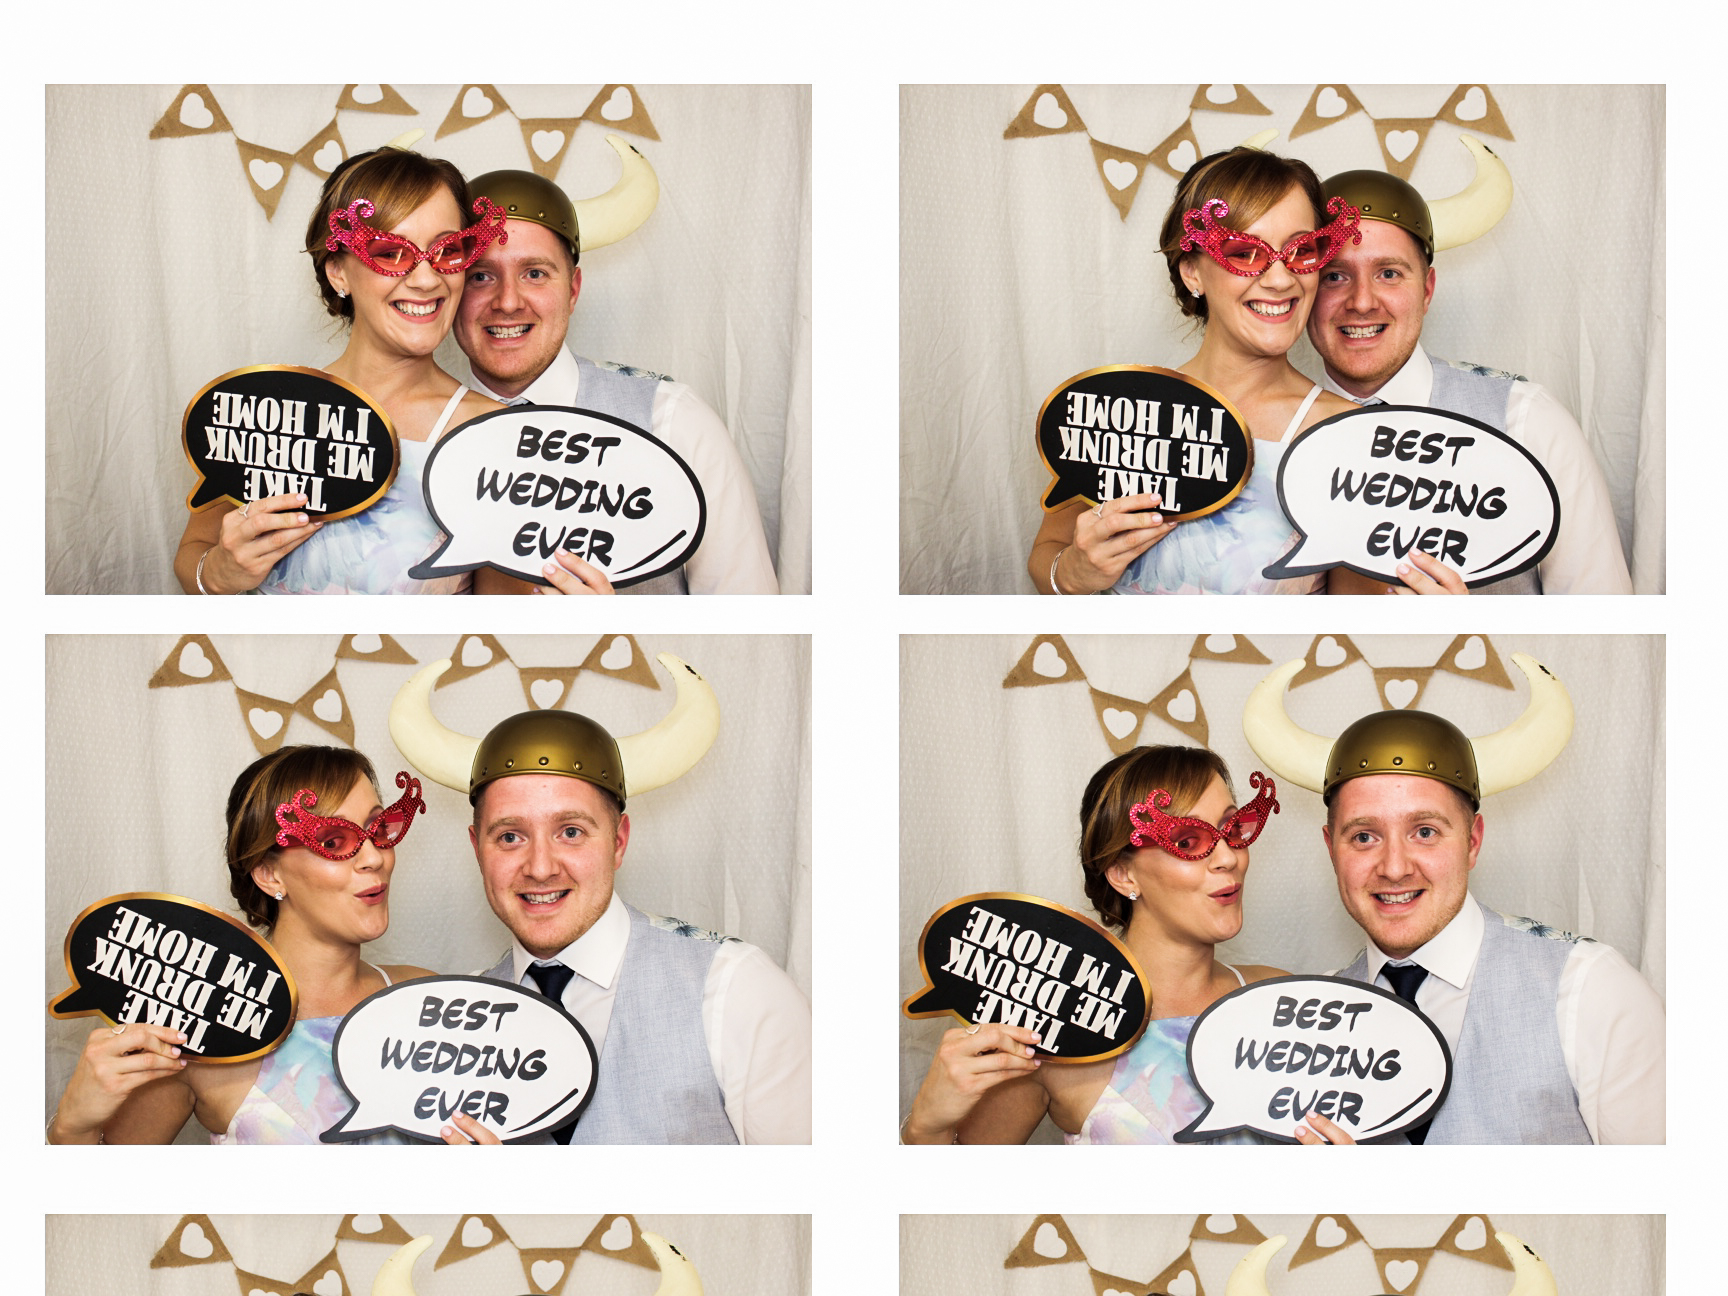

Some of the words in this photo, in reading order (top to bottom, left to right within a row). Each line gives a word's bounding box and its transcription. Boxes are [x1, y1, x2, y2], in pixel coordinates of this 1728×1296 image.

[212, 391, 307, 436] HOME
[316, 403, 371, 444] I'M
[1066, 391, 1161, 436] HOME
[1170, 403, 1225, 444] I'M
[204, 426, 317, 474] DRUNK
[327, 441, 376, 482] ME
[517, 425, 621, 467] BEST
[1058, 426, 1171, 474] DRUNK
[1181, 441, 1230, 482] ME
[1371, 425, 1475, 467] BEST
[243, 467, 328, 512] TAKE
[476, 467, 653, 519] WEDDING
[1097, 467, 1182, 512] TAKE
[1330, 467, 1507, 519] WEDDING
[512, 522, 615, 567] EVER
[1366, 522, 1469, 567] EVER
[107, 906, 218, 978] HOME
[961, 906, 1072, 978] HOME
[86, 937, 217, 1016] DRUNK
[217, 953, 282, 1005] I'M
[940, 937, 1071, 1016] DRUNK
[1071, 953, 1136, 1005] I'M
[216, 992, 273, 1040] ME
[419, 996, 518, 1032] BEST
[1070, 992, 1127, 1040] ME
[1273, 996, 1372, 1032] BEST
[380, 1037, 547, 1081] WEDDING
[1234, 1037, 1401, 1081] WEDDING
[414, 1086, 510, 1126] EVER
[1268, 1086, 1364, 1126] EVER
